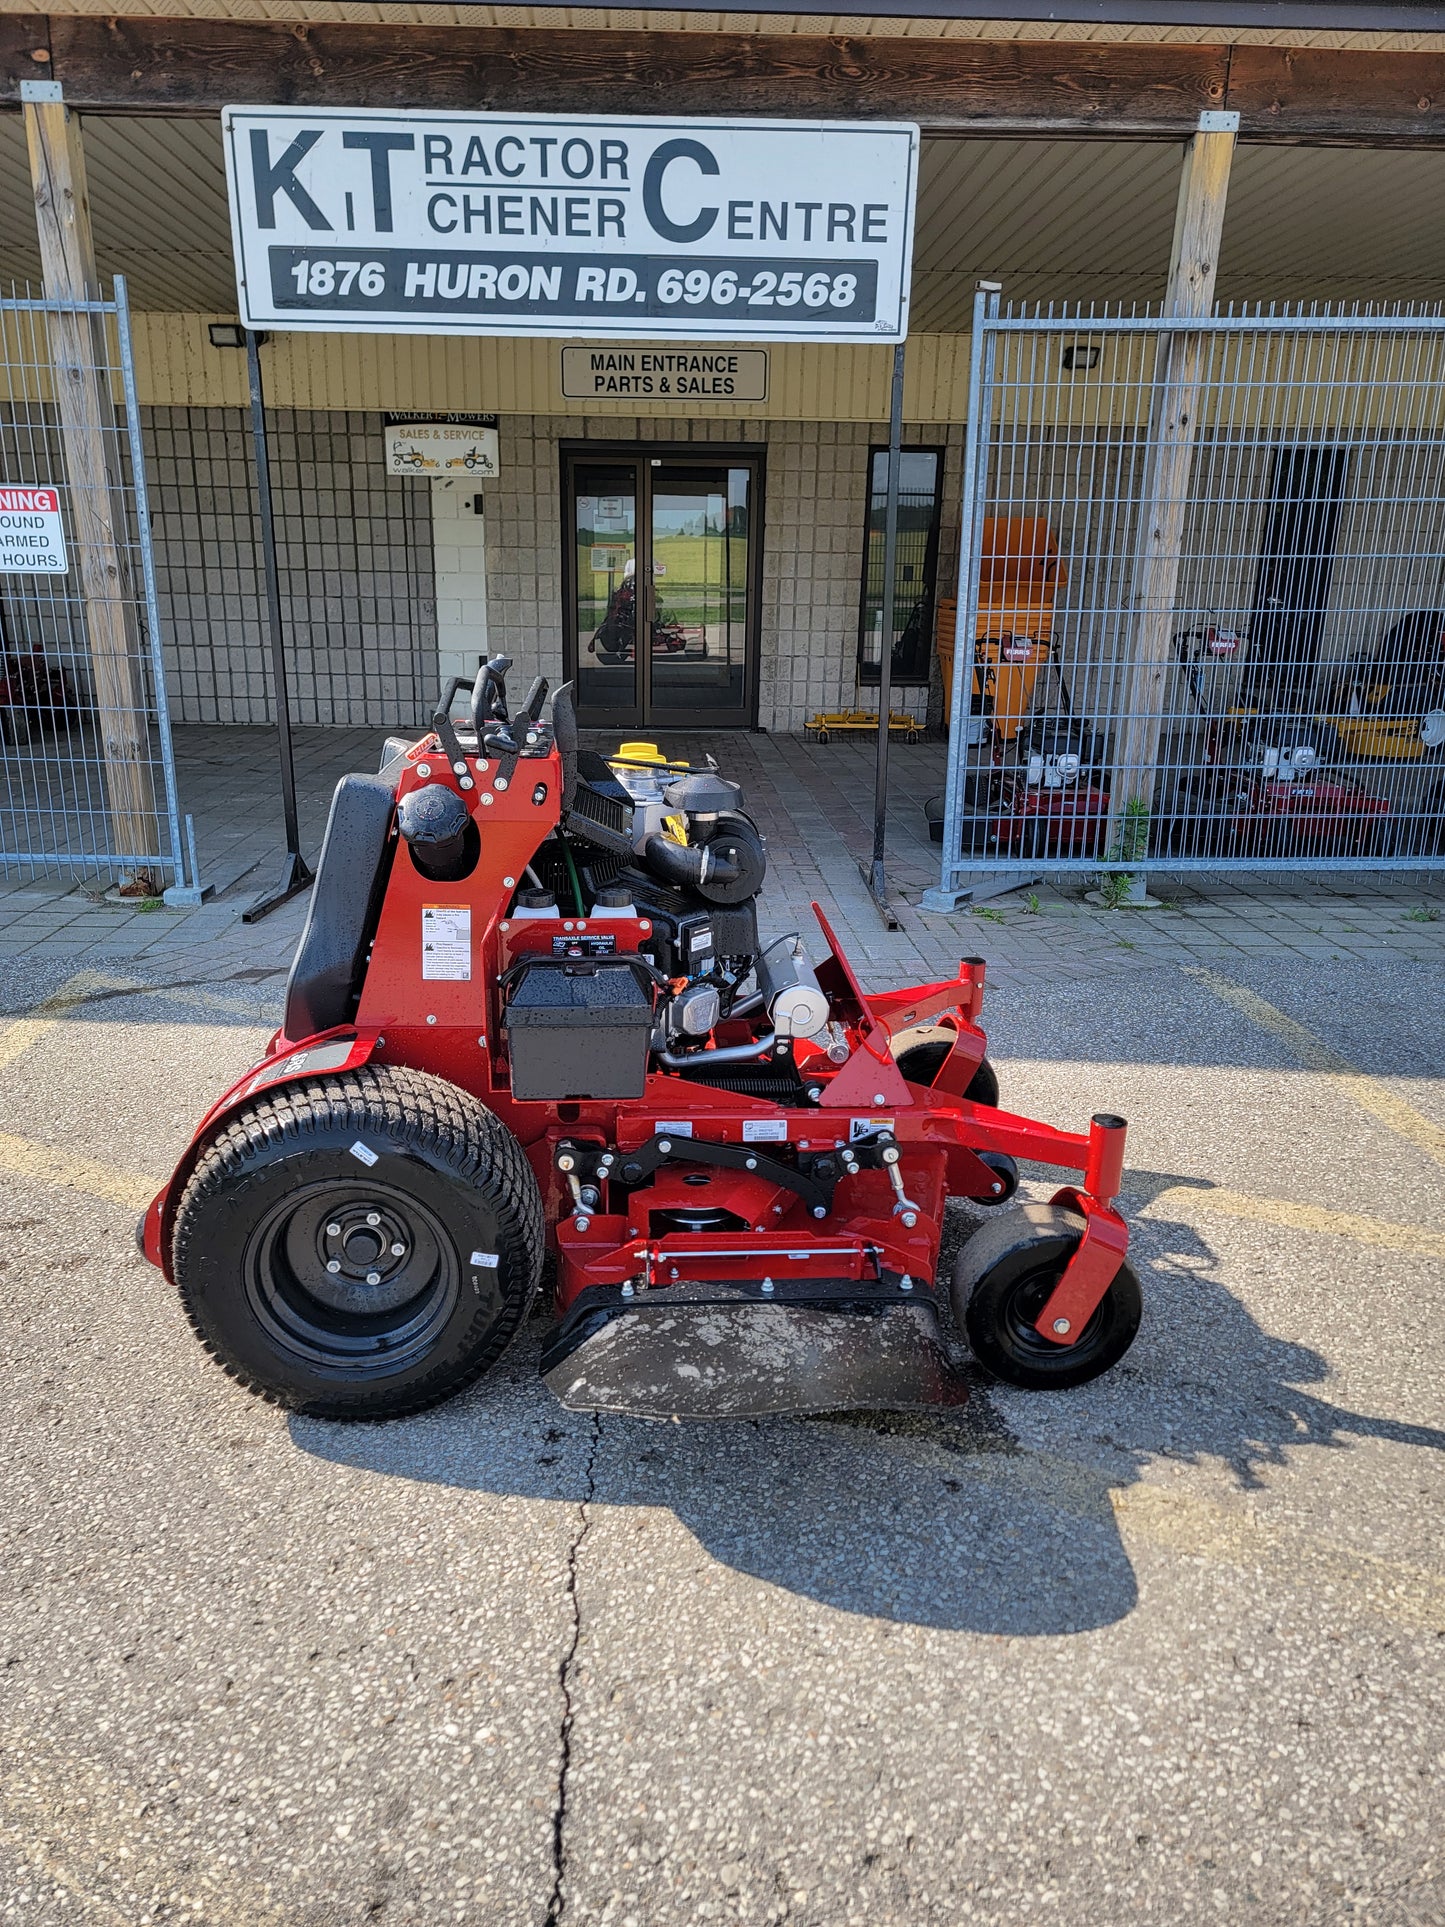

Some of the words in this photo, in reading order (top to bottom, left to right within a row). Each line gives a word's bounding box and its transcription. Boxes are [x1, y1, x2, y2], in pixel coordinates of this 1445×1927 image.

[427, 193, 627, 238] CHENER
[290, 259, 386, 298] 1876
[403, 262, 563, 301] HURON
[574, 266, 647, 303] RD.
[656, 268, 858, 308] 696-2568
[590, 354, 635, 371] MAIN
[641, 354, 738, 373] ENTRANCE
[594, 375, 654, 393] PARTS
[659, 376, 671, 393] &
[676, 376, 735, 394] SALES
[399, 429, 430, 440] SALES
[433, 429, 441, 440] &
[443, 430, 485, 440] SERVICE
[0, 515, 45, 529] OUND
[3, 553, 63, 567] HOURS.
